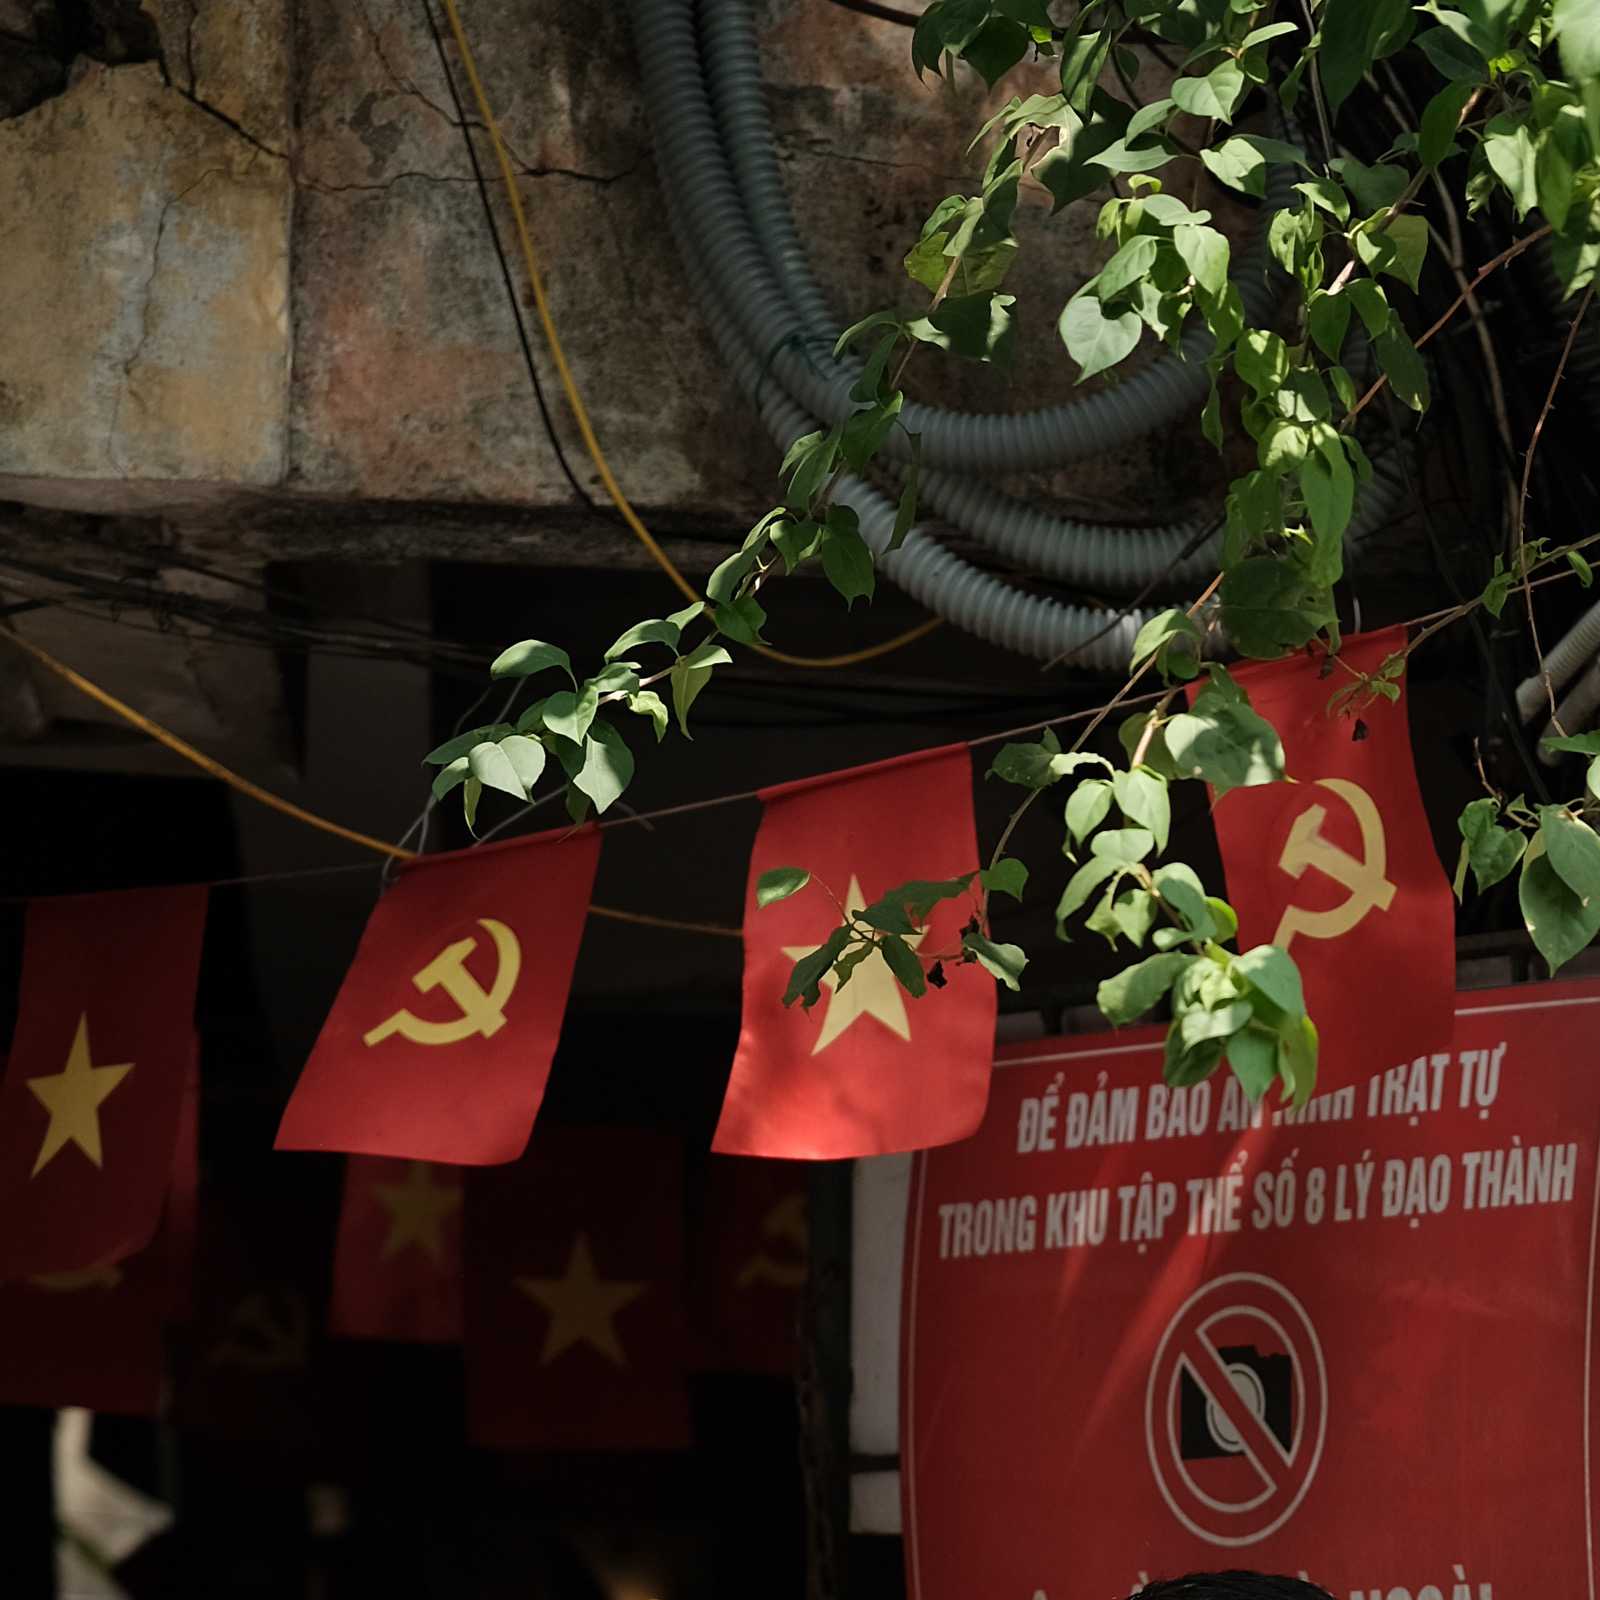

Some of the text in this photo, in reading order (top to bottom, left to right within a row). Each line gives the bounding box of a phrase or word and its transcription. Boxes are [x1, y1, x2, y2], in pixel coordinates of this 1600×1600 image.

[1016, 1071, 1066, 1154] ĐỂ
[1065, 1070, 1139, 1149] ĐẢM
[1459, 1041, 1507, 1120] TỰ
[938, 1135, 1578, 1259] TRONG KHU TẬP THỂ SỐ 8 LÝ ĐẠO THÀNH
